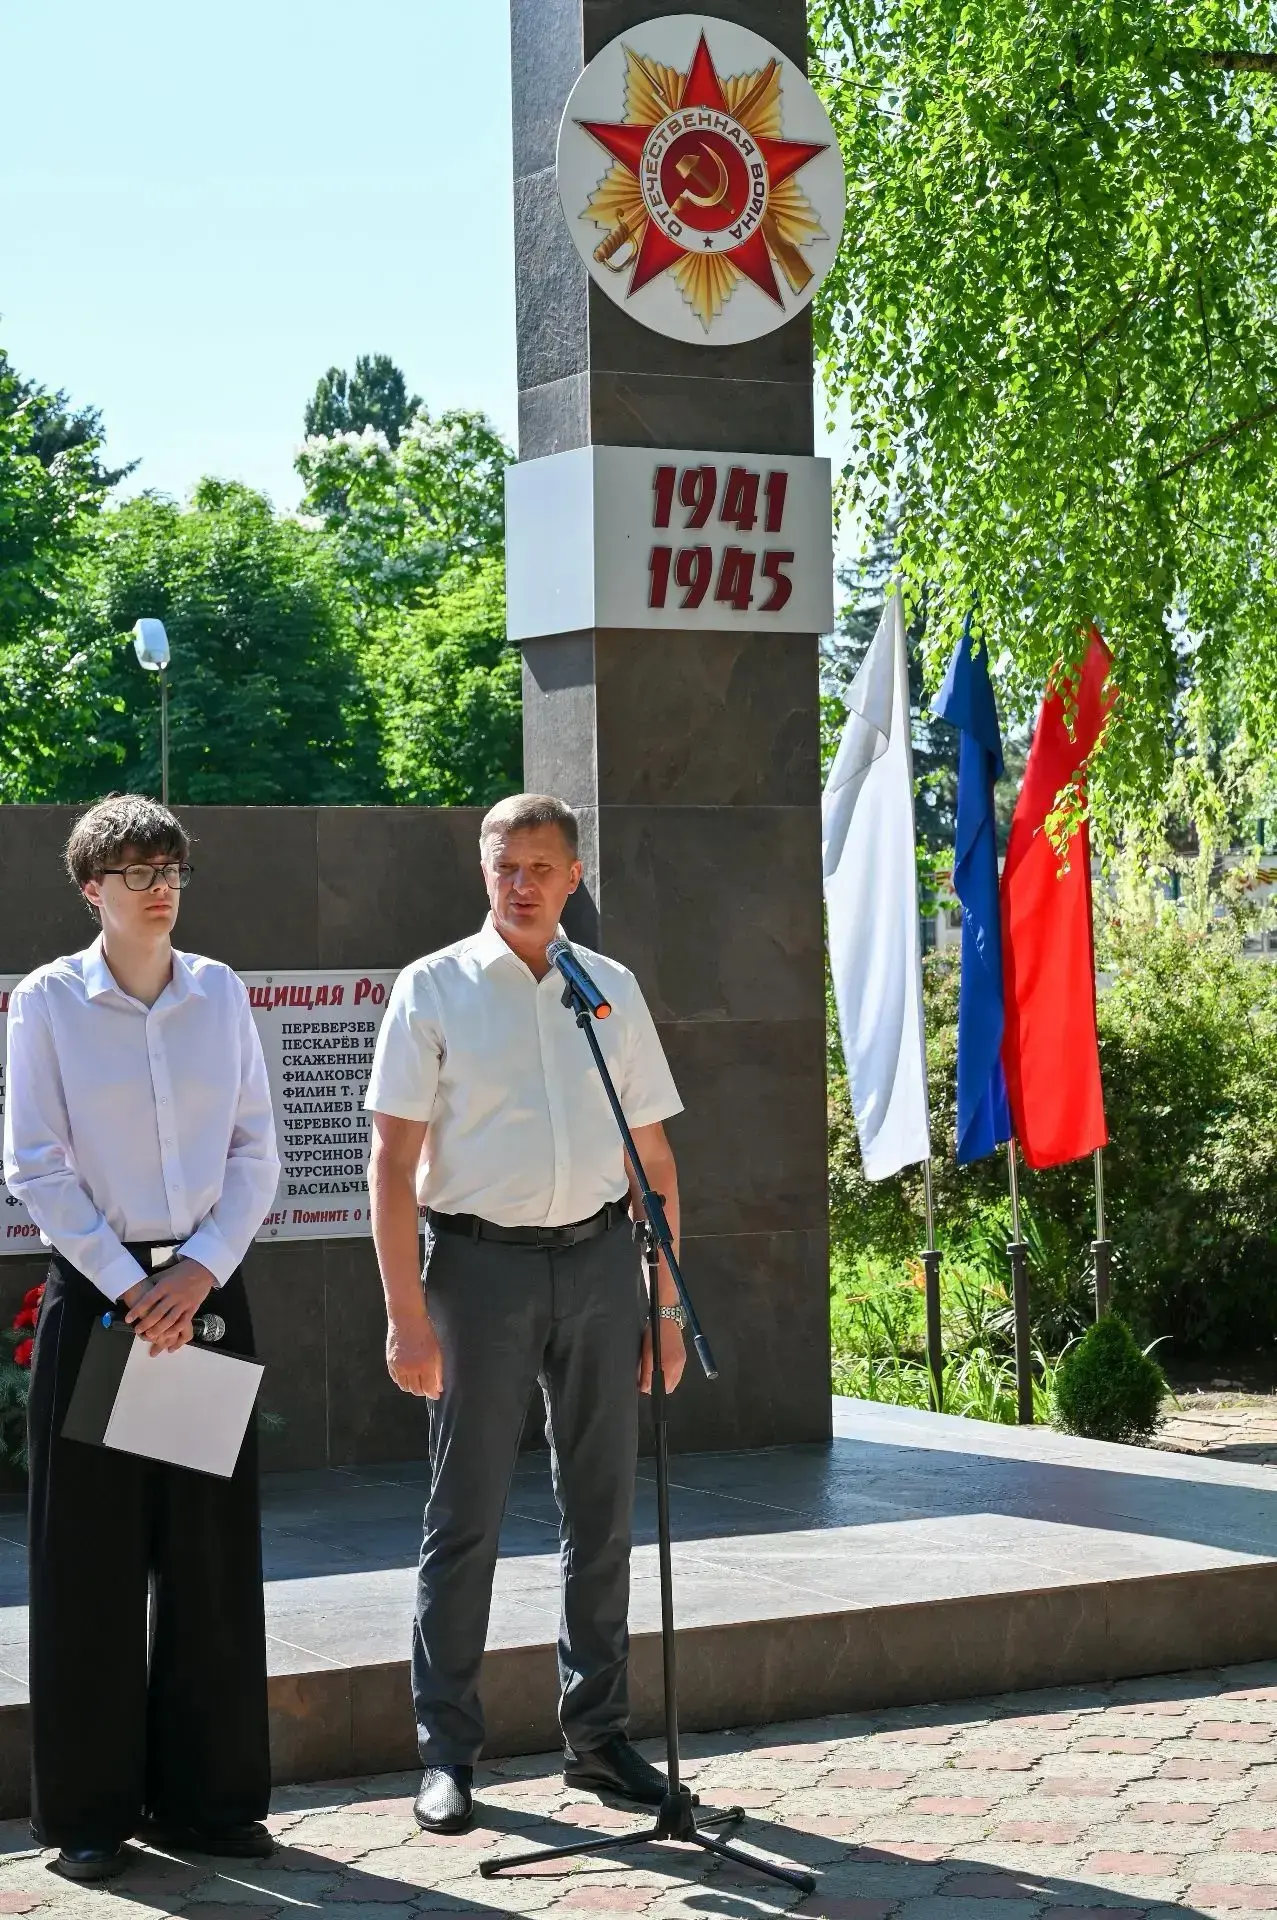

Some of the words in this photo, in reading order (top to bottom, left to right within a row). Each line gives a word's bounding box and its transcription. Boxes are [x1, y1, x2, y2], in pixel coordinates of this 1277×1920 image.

[646, 112, 755, 237] ОТЕЧЕСТВЕННАЯ
[653, 465, 788, 532] 1941
[648, 545, 795, 612] 1945
[282, 1021, 376, 1034] ПЕРЕВЕРЗЕВ
[282, 1035, 360, 1050] ПЕСКАРЁВ
[282, 1086, 336, 1098] ФИЛИН
[341, 1085, 354, 1096] Т.
[283, 1101, 353, 1114] ЧАПЛИЕВ
[283, 1117, 352, 1130] ЧЕРЕВКО
[356, 1117, 371, 1128] П.
[284, 1132, 368, 1146] ЧЕРКАШИН
[284, 1148, 363, 1162] ЧУРСИНОВ
[284, 1164, 363, 1178] ЧУРСИНОВ
